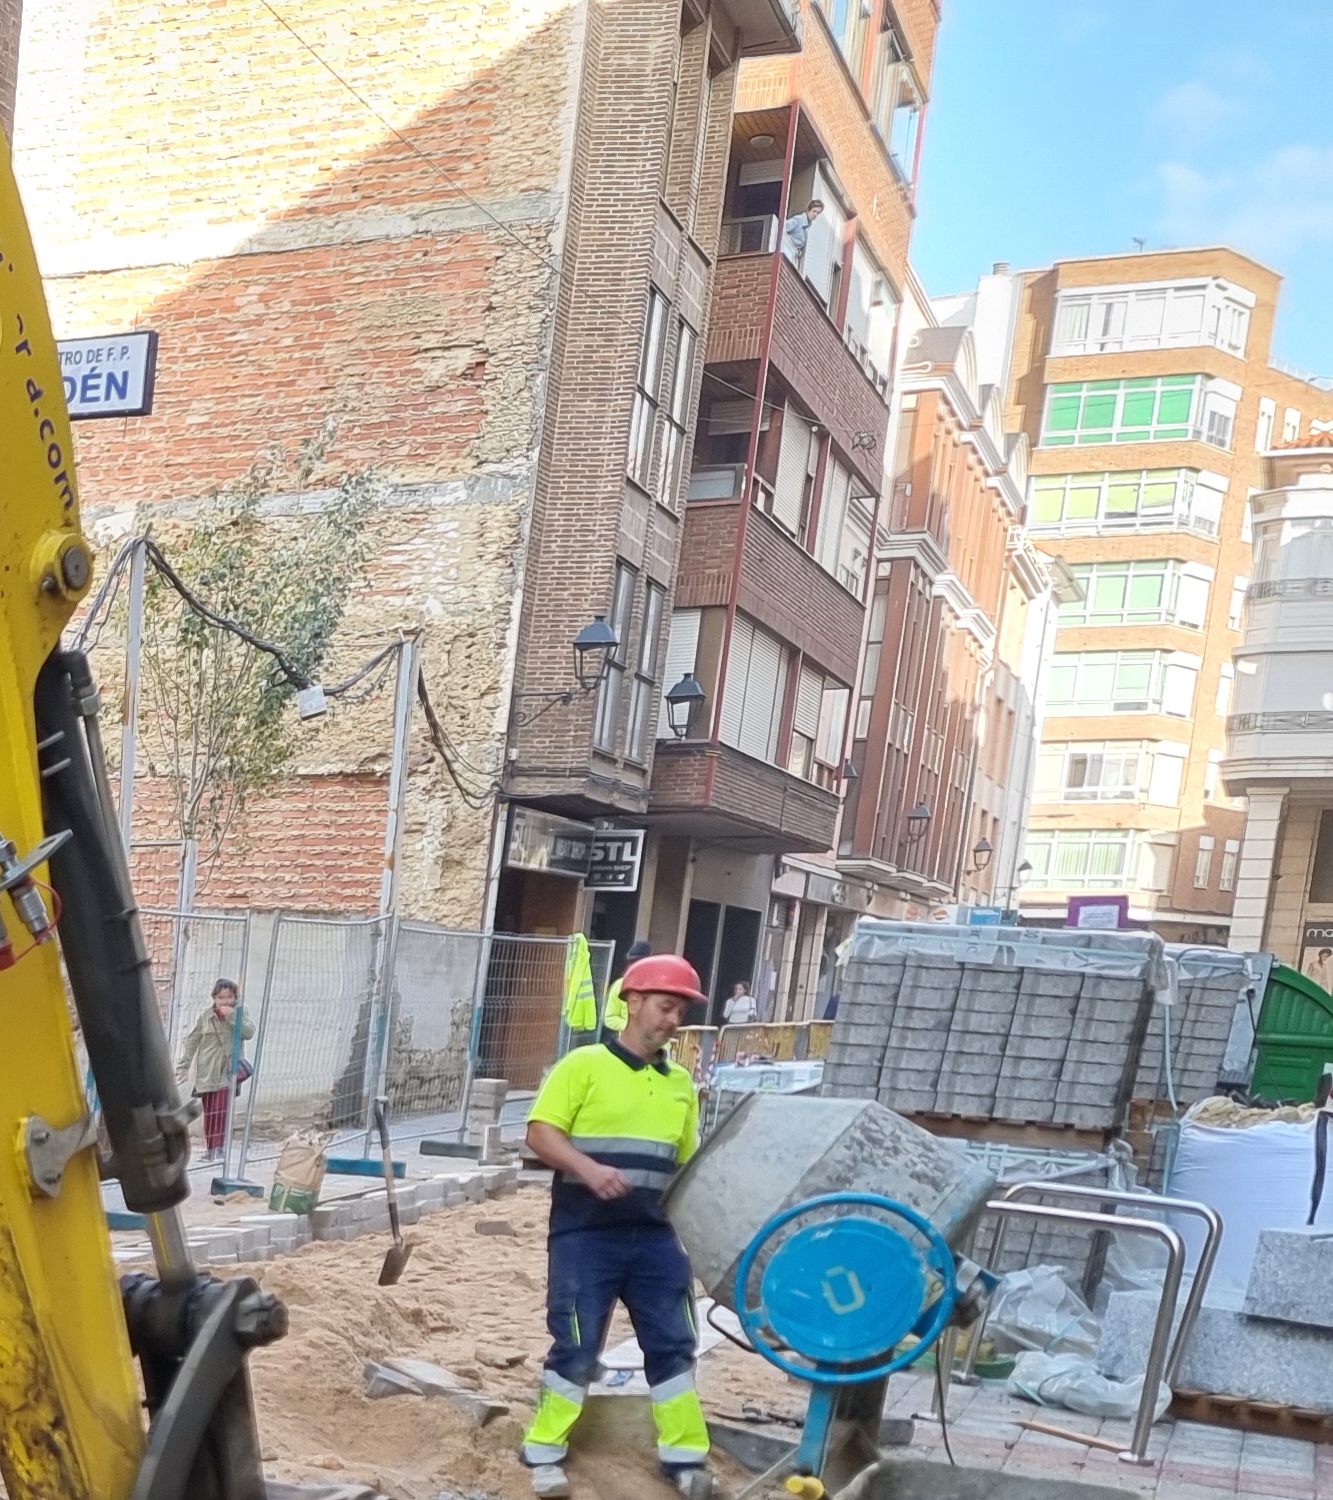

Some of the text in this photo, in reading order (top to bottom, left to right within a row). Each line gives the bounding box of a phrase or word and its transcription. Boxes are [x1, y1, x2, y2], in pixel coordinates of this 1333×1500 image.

[59, 349, 82, 365] TRO
[86, 346, 103, 364] DE
[63, 366, 130, 405] DÉN
